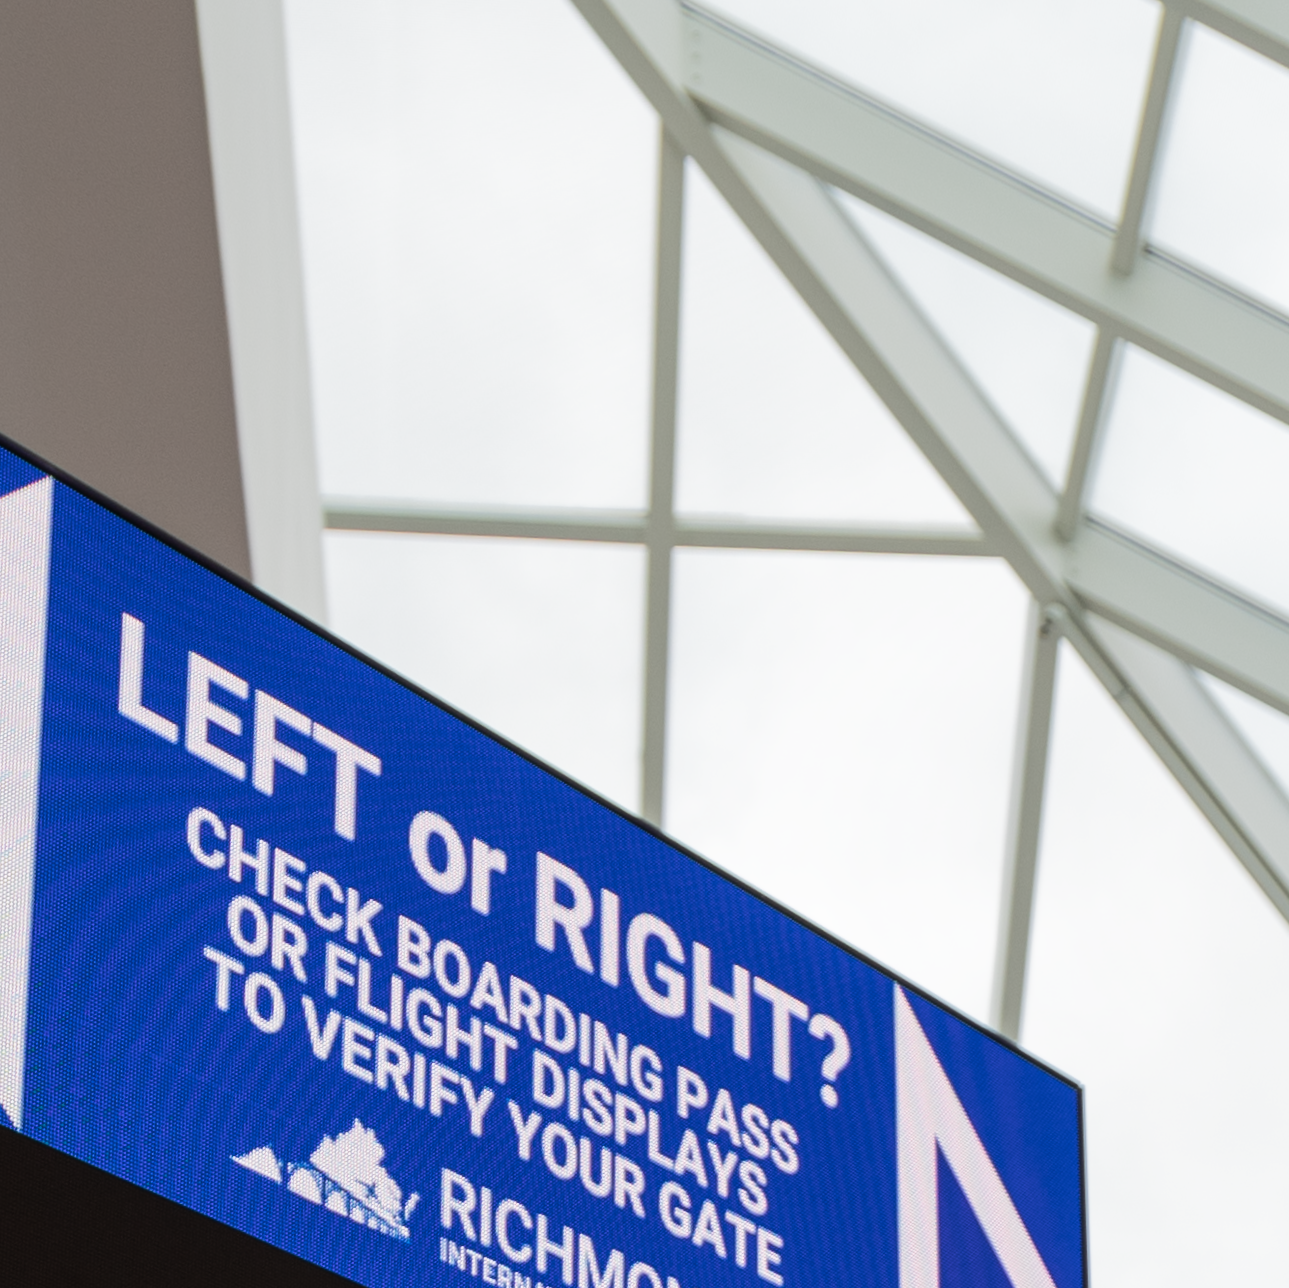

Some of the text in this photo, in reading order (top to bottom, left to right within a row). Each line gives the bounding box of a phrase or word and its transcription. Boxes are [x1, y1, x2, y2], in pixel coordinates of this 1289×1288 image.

[118, 611, 851, 1107] LEFT or RIGHT?
[186, 806, 799, 1174] CHECK BOARDING PASS
[203, 947, 784, 1287] TO VERIFY YOUR GATE
[227, 895, 768, 1217] OR FLIGHT DISPLAYS
